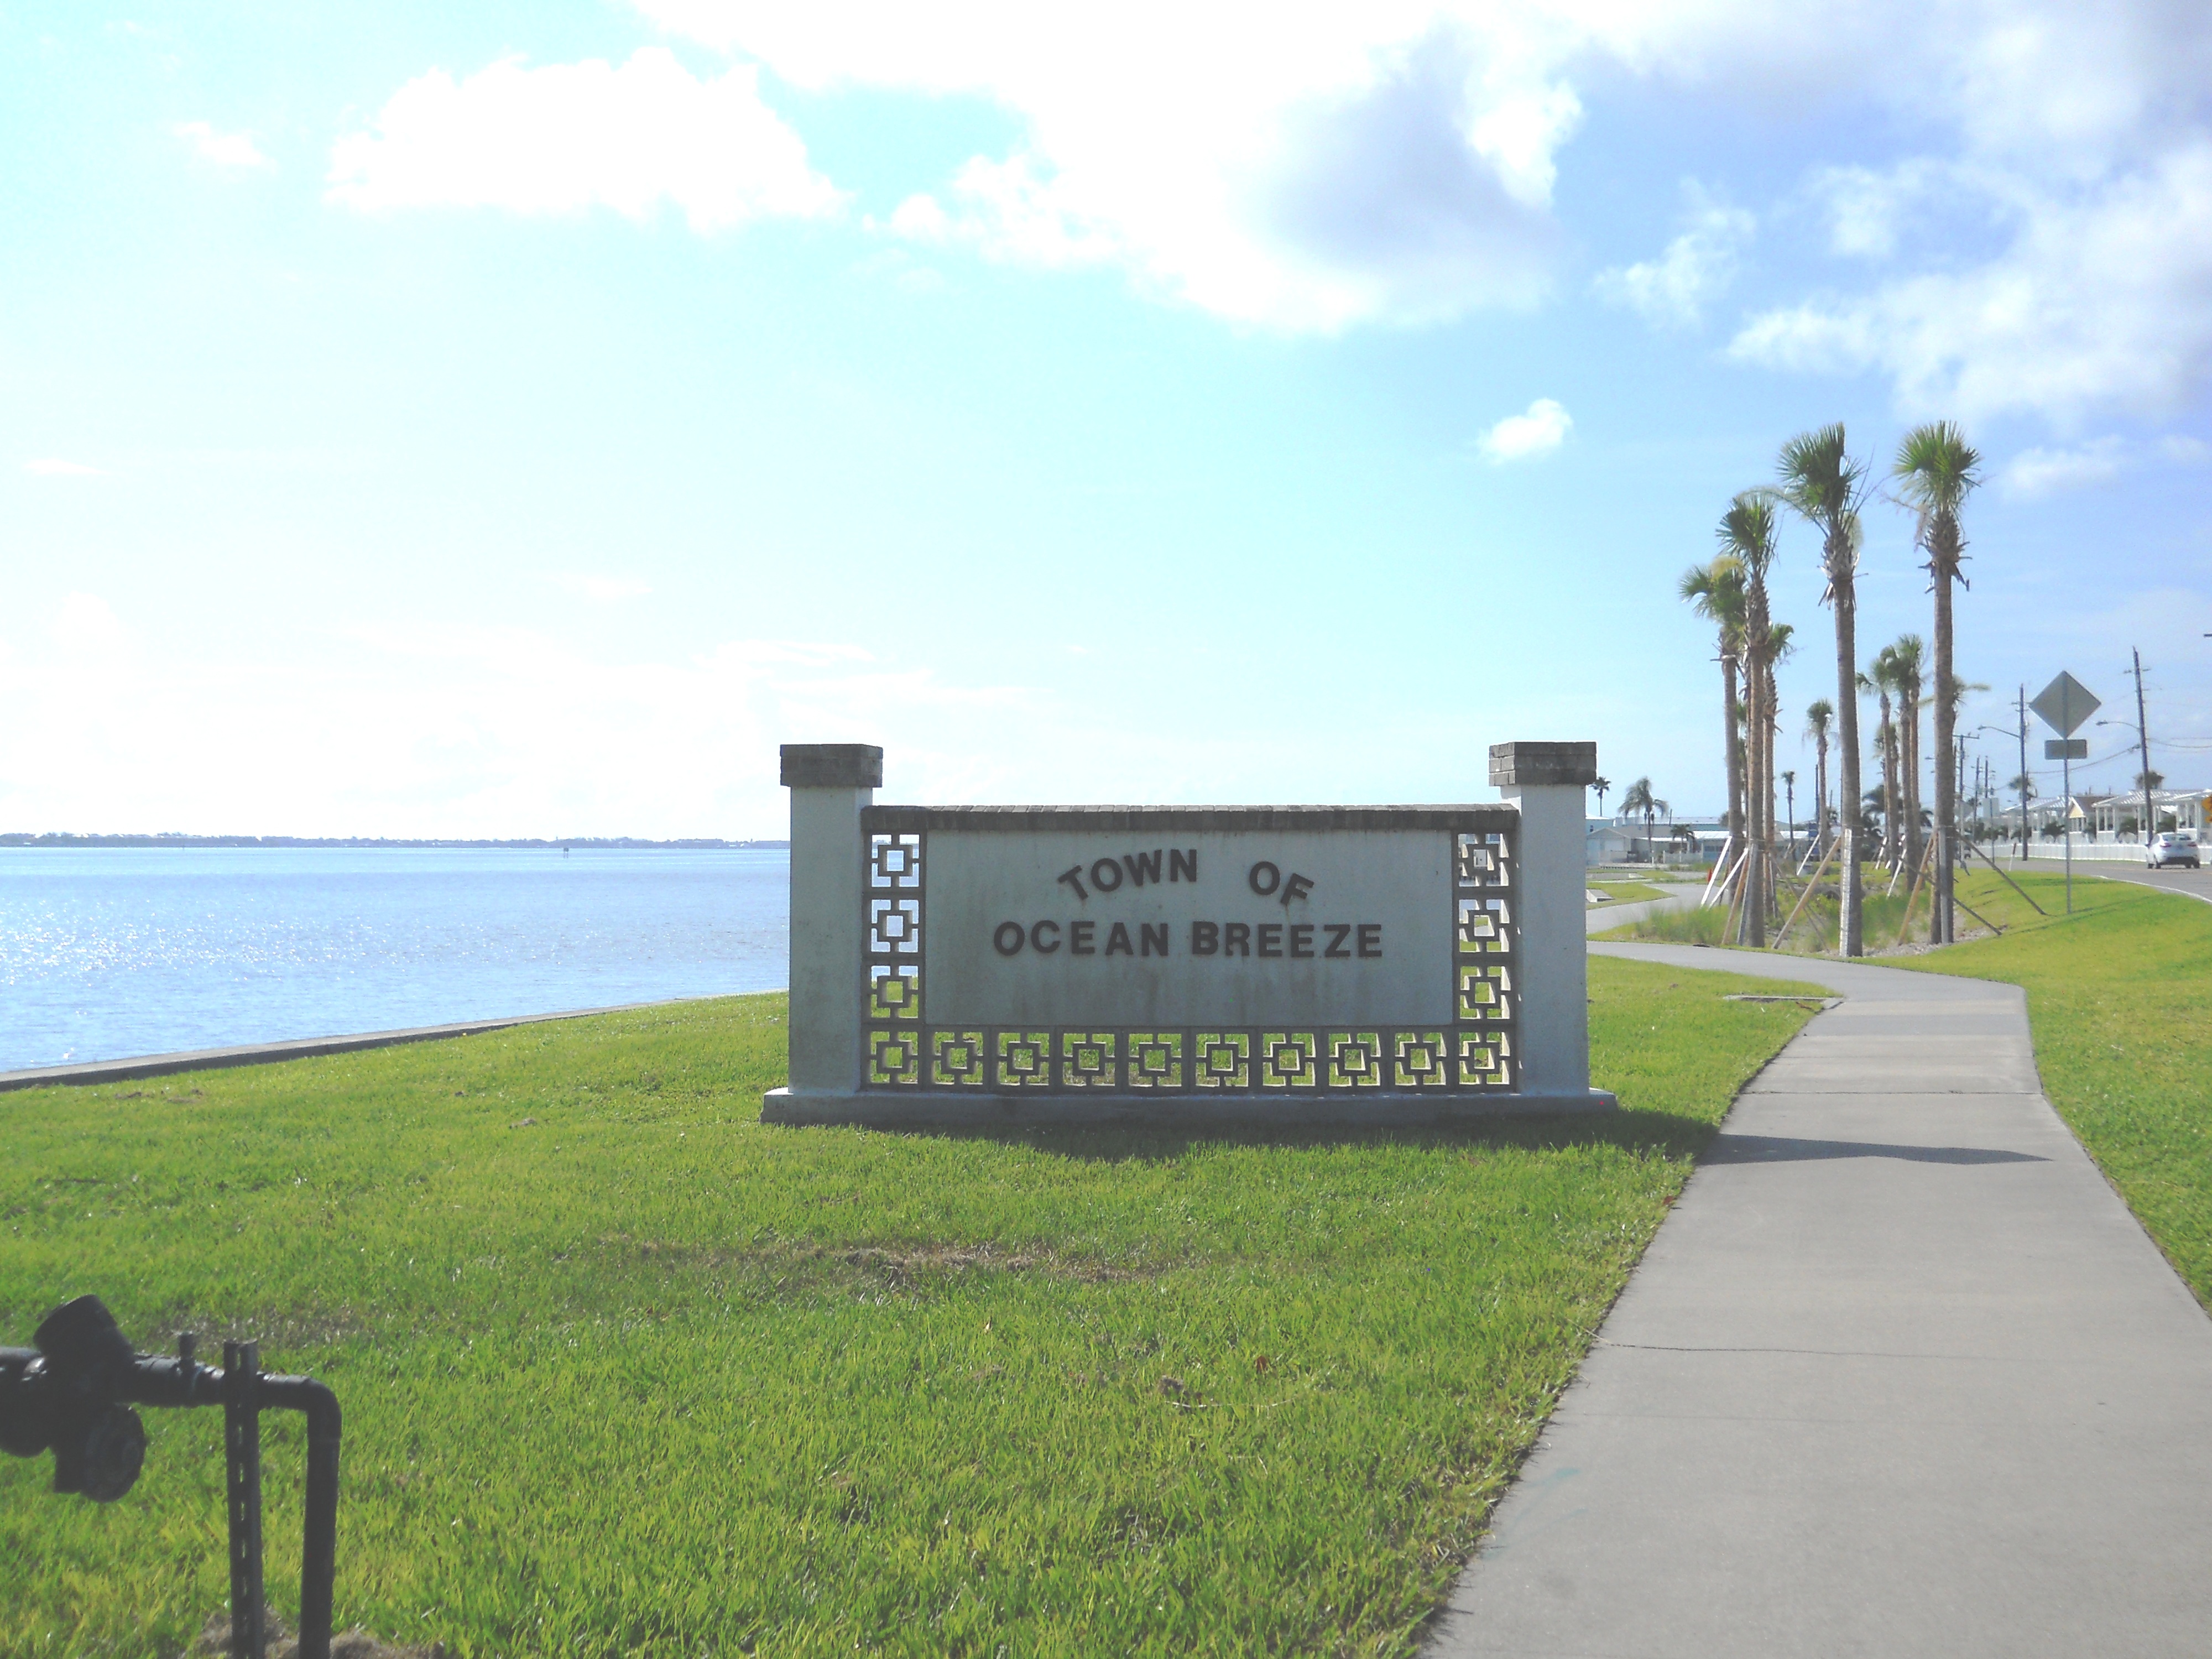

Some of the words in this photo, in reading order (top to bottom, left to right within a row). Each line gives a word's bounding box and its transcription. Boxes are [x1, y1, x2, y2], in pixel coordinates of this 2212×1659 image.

[1058, 849, 1198, 901] TOWN
[1249, 861, 1314, 905] OF
[994, 920, 1169, 957] OCEAN
[1192, 921, 1383, 957] BREEZE
